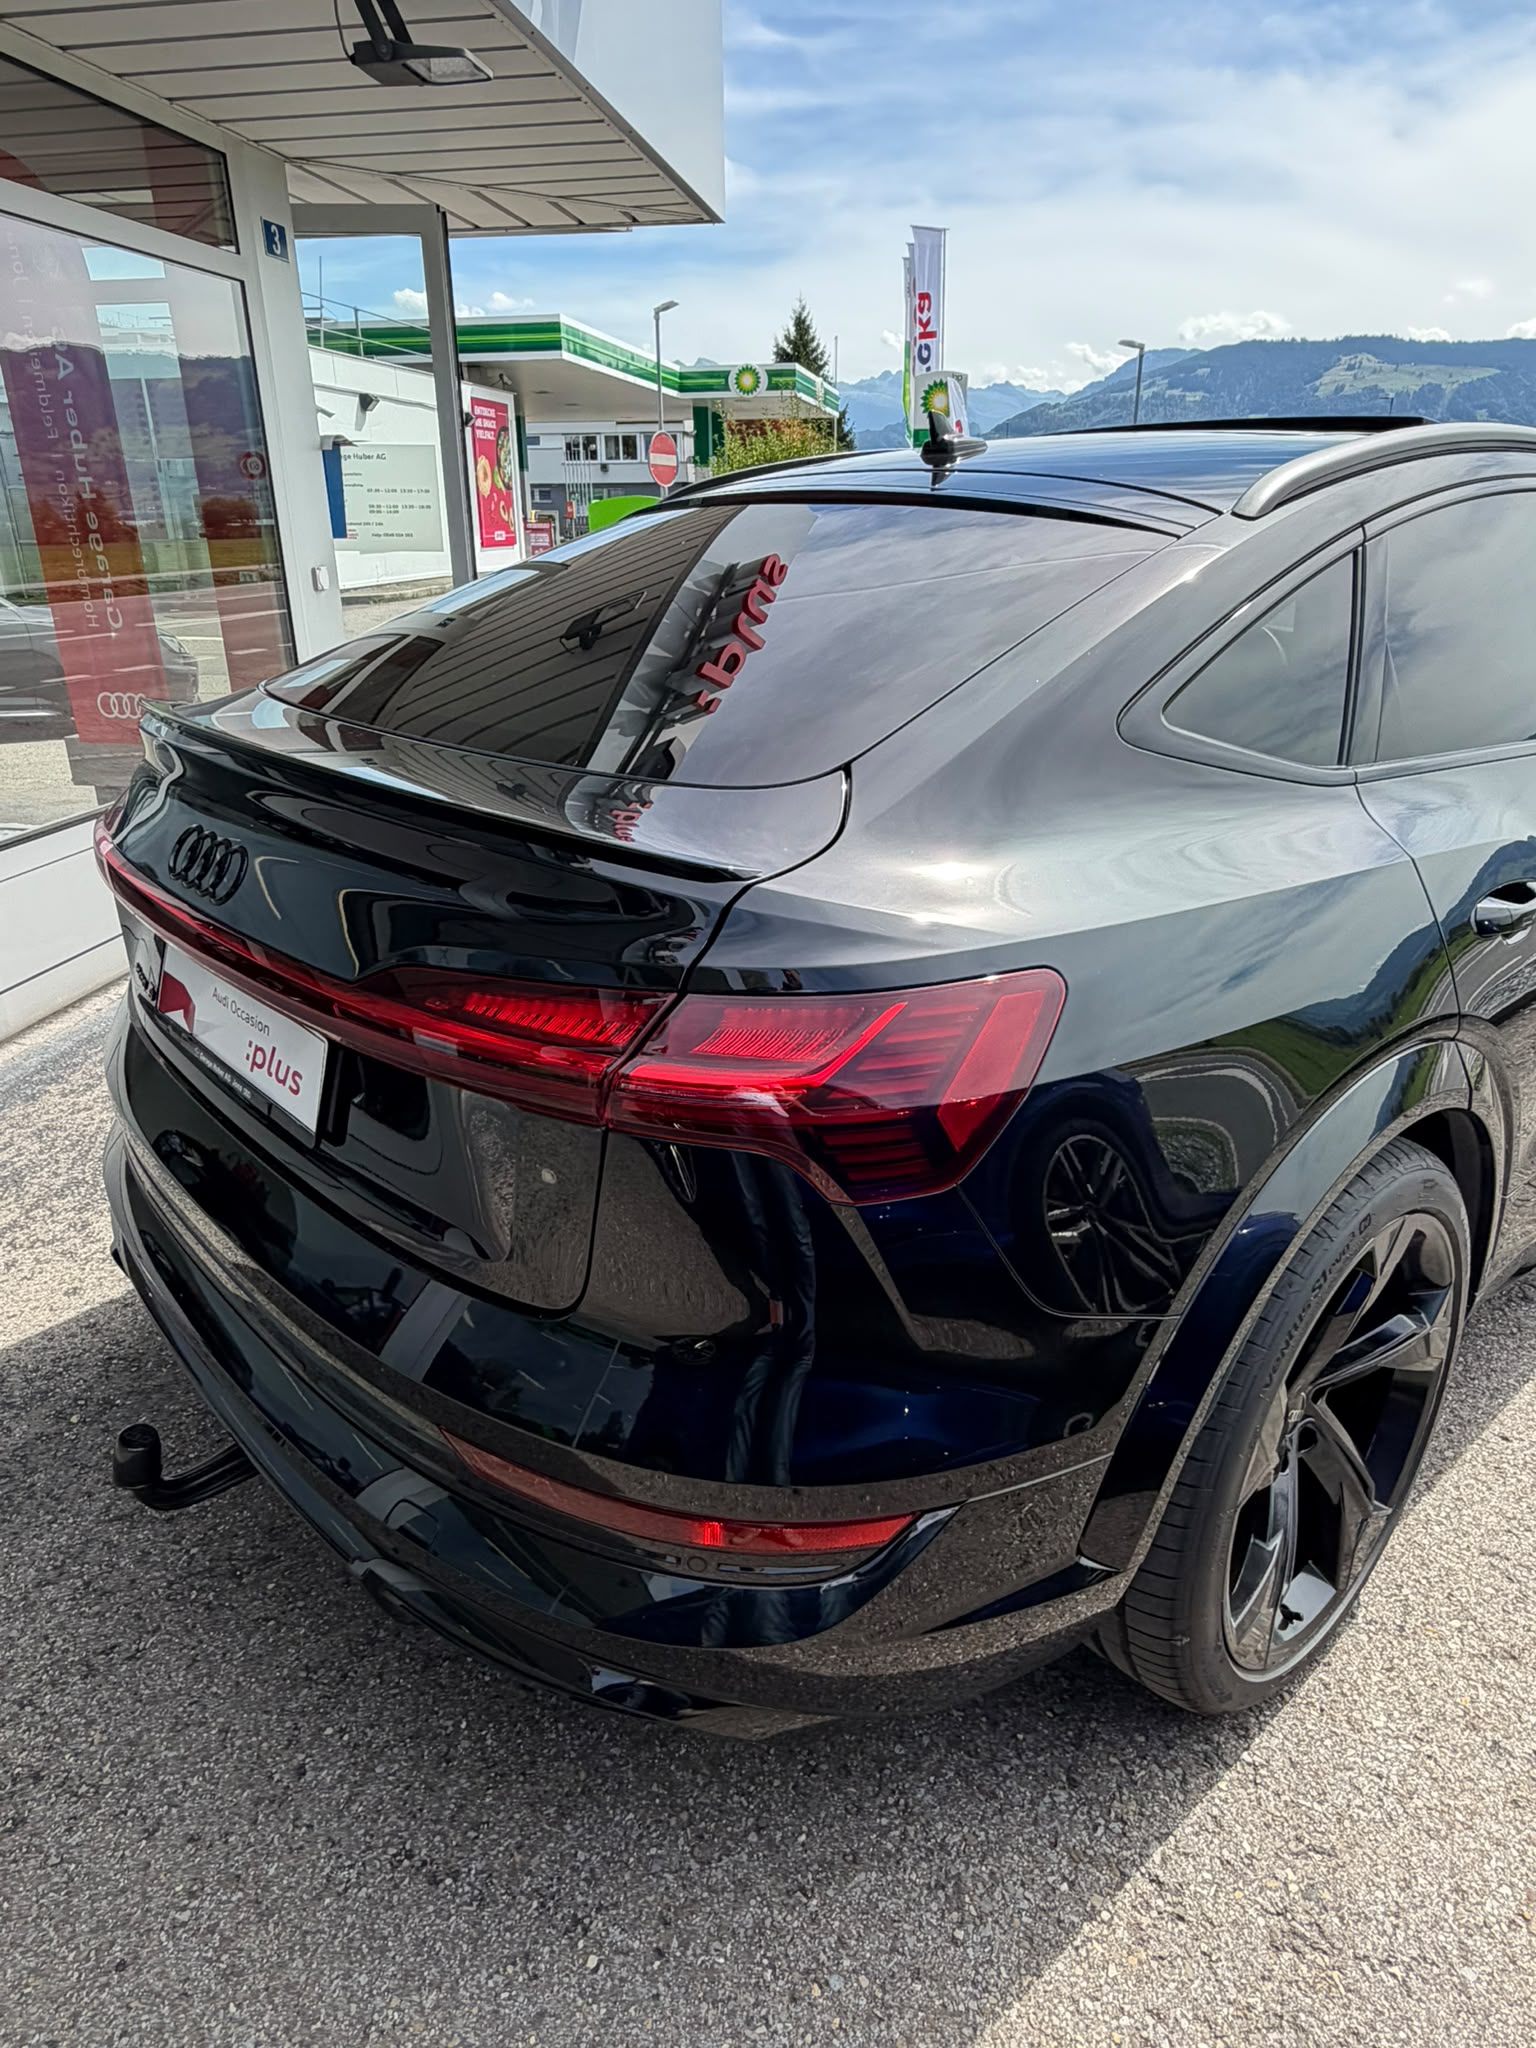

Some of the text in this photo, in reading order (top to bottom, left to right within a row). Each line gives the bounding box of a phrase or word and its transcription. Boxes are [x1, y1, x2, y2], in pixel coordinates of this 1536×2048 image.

[270, 224, 281, 255] 3
[353, 453, 374, 461] Huber
[376, 453, 387, 461] AG
[212, 986, 270, 1036] Audi Occasion
[245, 1040, 304, 1096] :plus
